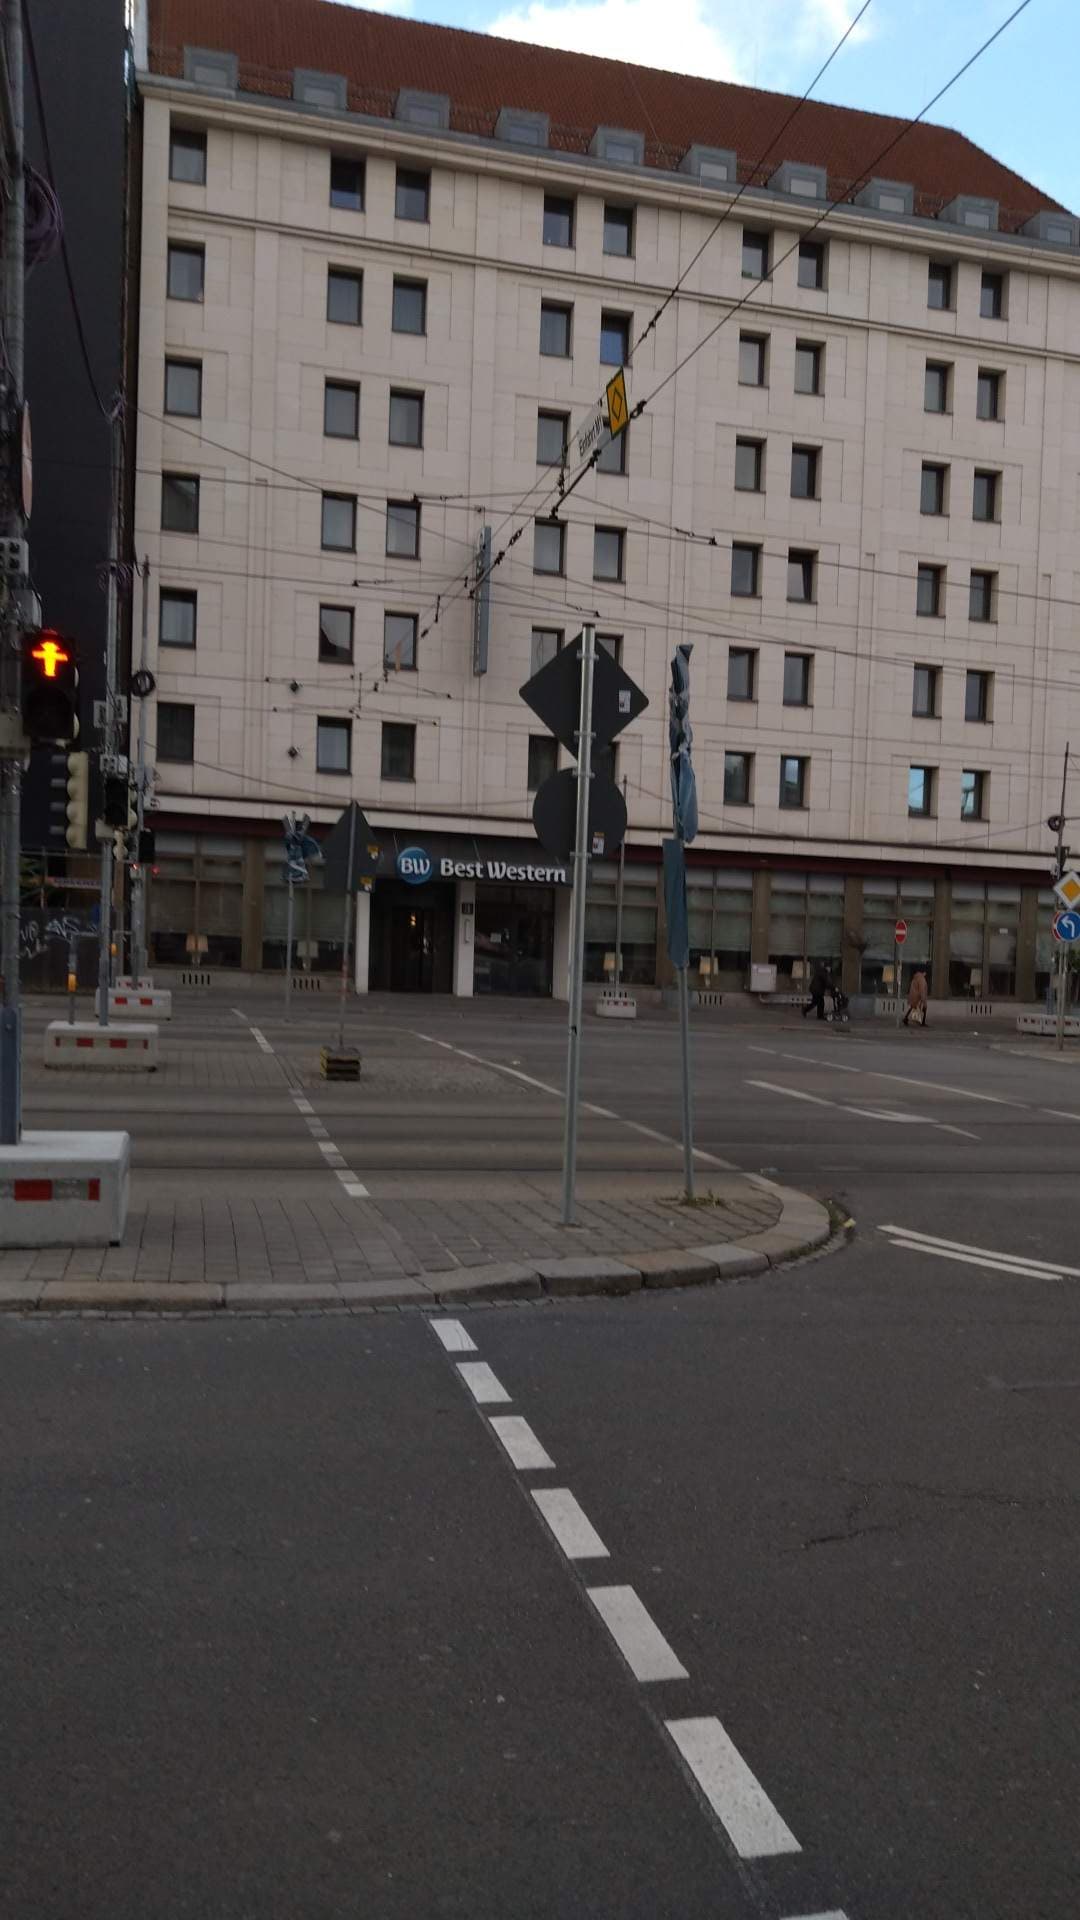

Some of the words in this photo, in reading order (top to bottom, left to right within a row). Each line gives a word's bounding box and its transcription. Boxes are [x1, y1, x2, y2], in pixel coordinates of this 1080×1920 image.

[400, 857, 430, 874] BW
[440, 858, 483, 878] Best
[487, 861, 567, 883] Western
